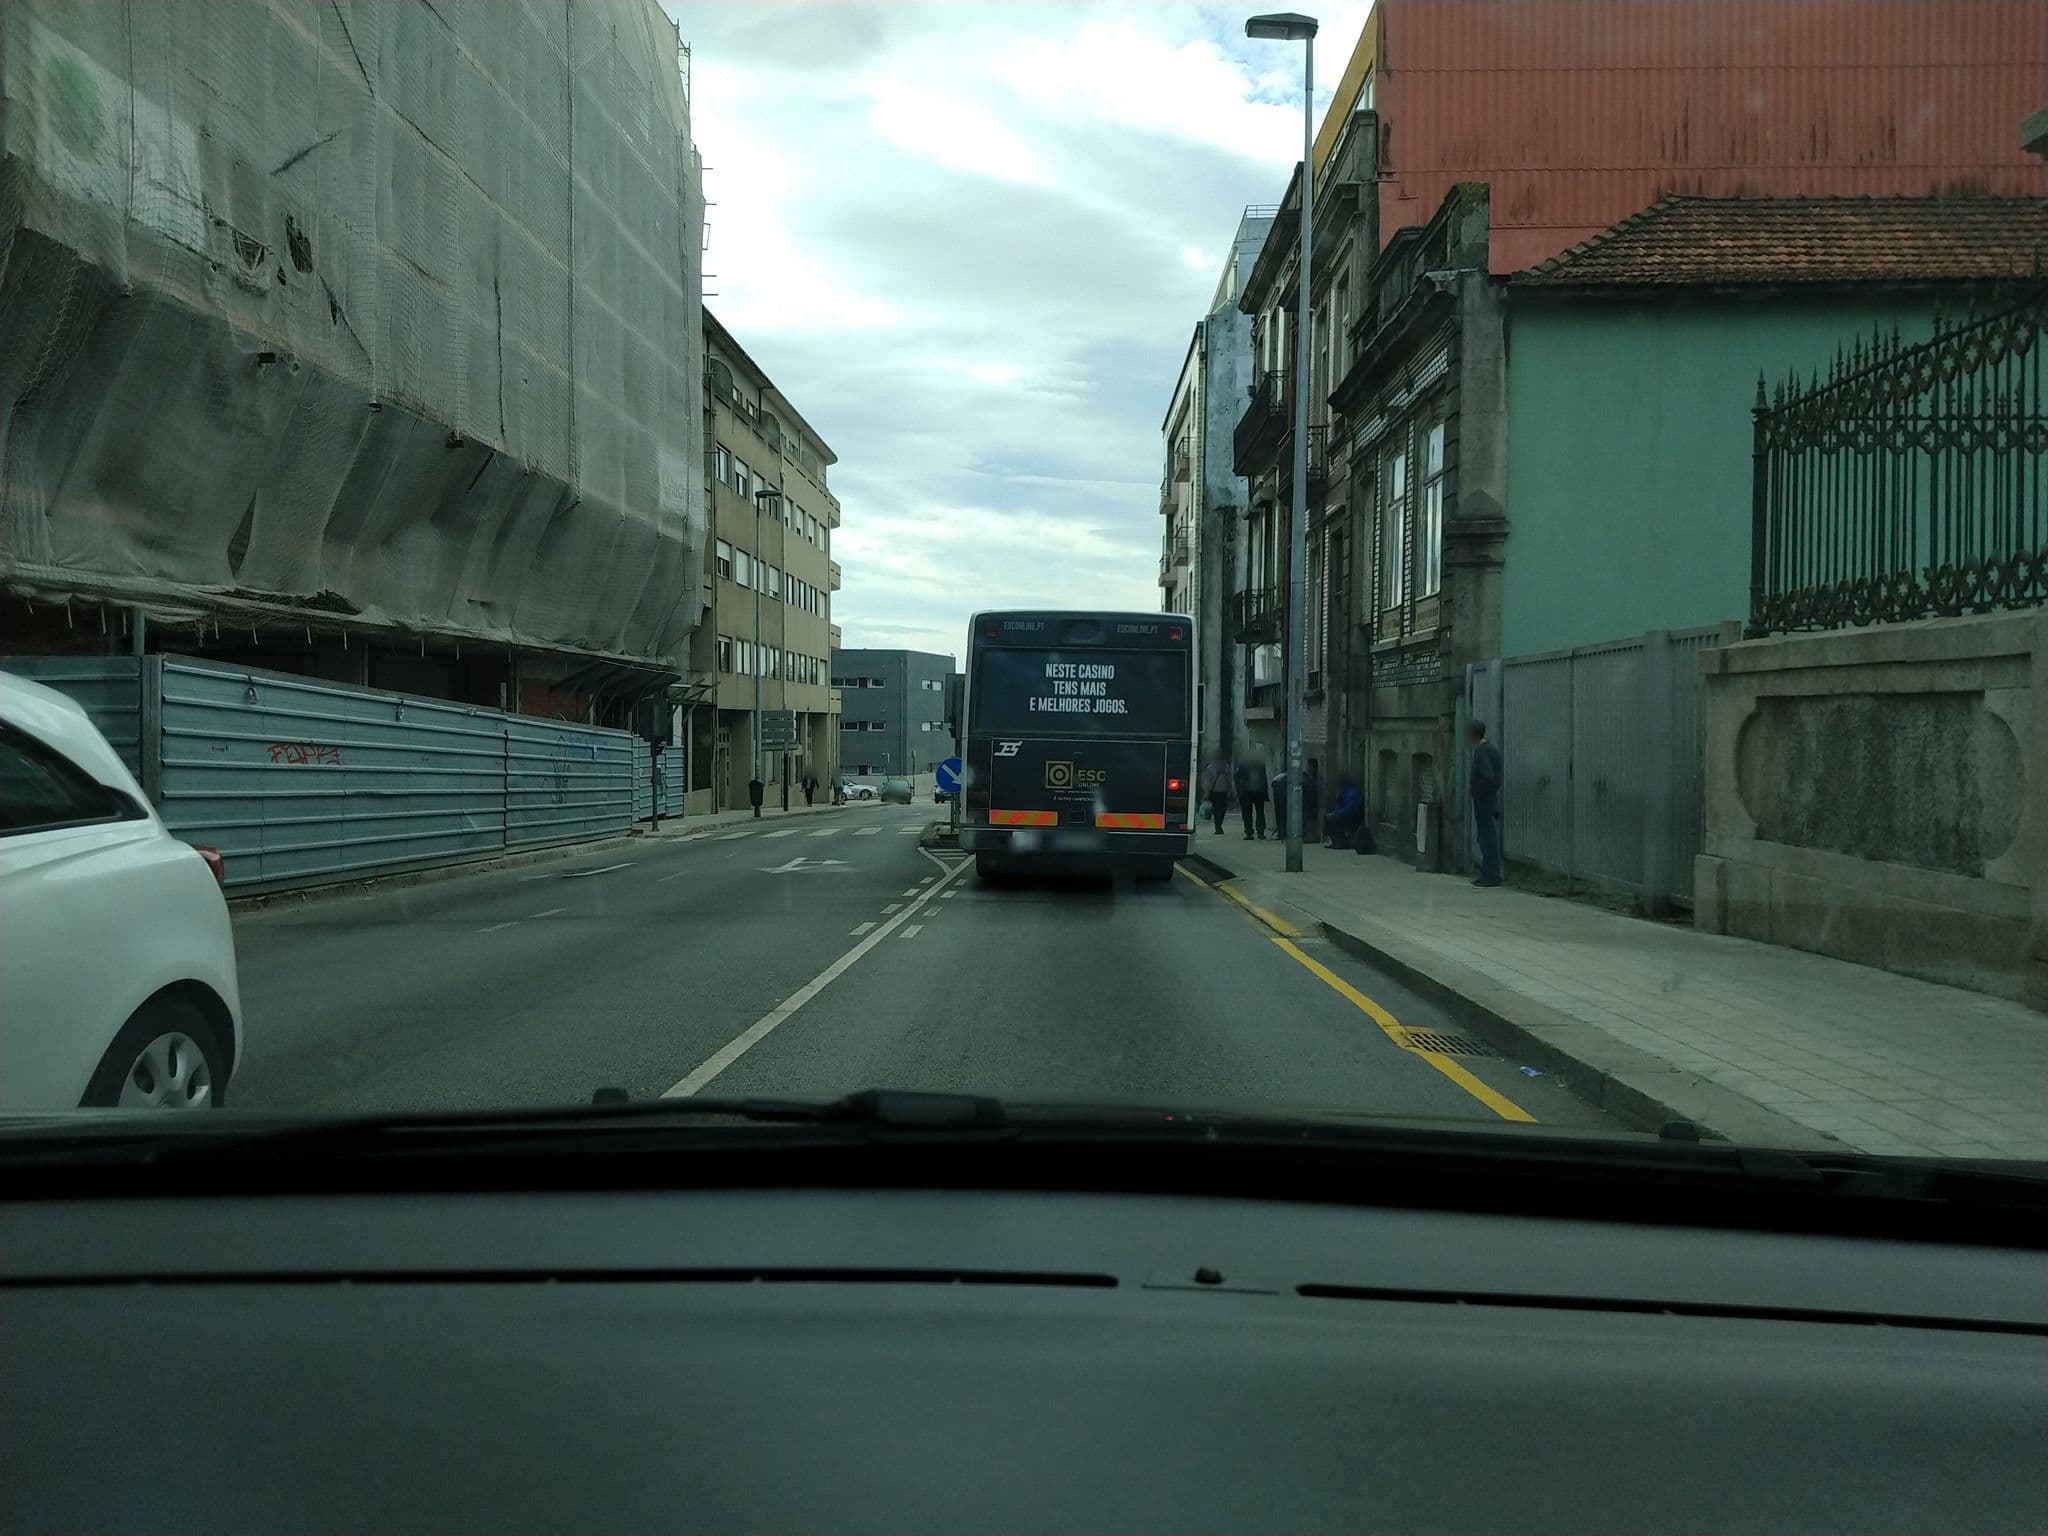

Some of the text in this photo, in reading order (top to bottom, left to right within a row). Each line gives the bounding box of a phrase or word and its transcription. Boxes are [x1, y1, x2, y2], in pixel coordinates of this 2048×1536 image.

[1045, 663, 1115, 680] NESTE CASINO
[1053, 681, 1107, 697] TENS MAIS
[1029, 697, 1129, 714] E MELHORES JOGOS.
[1077, 769, 1107, 782] ESC
